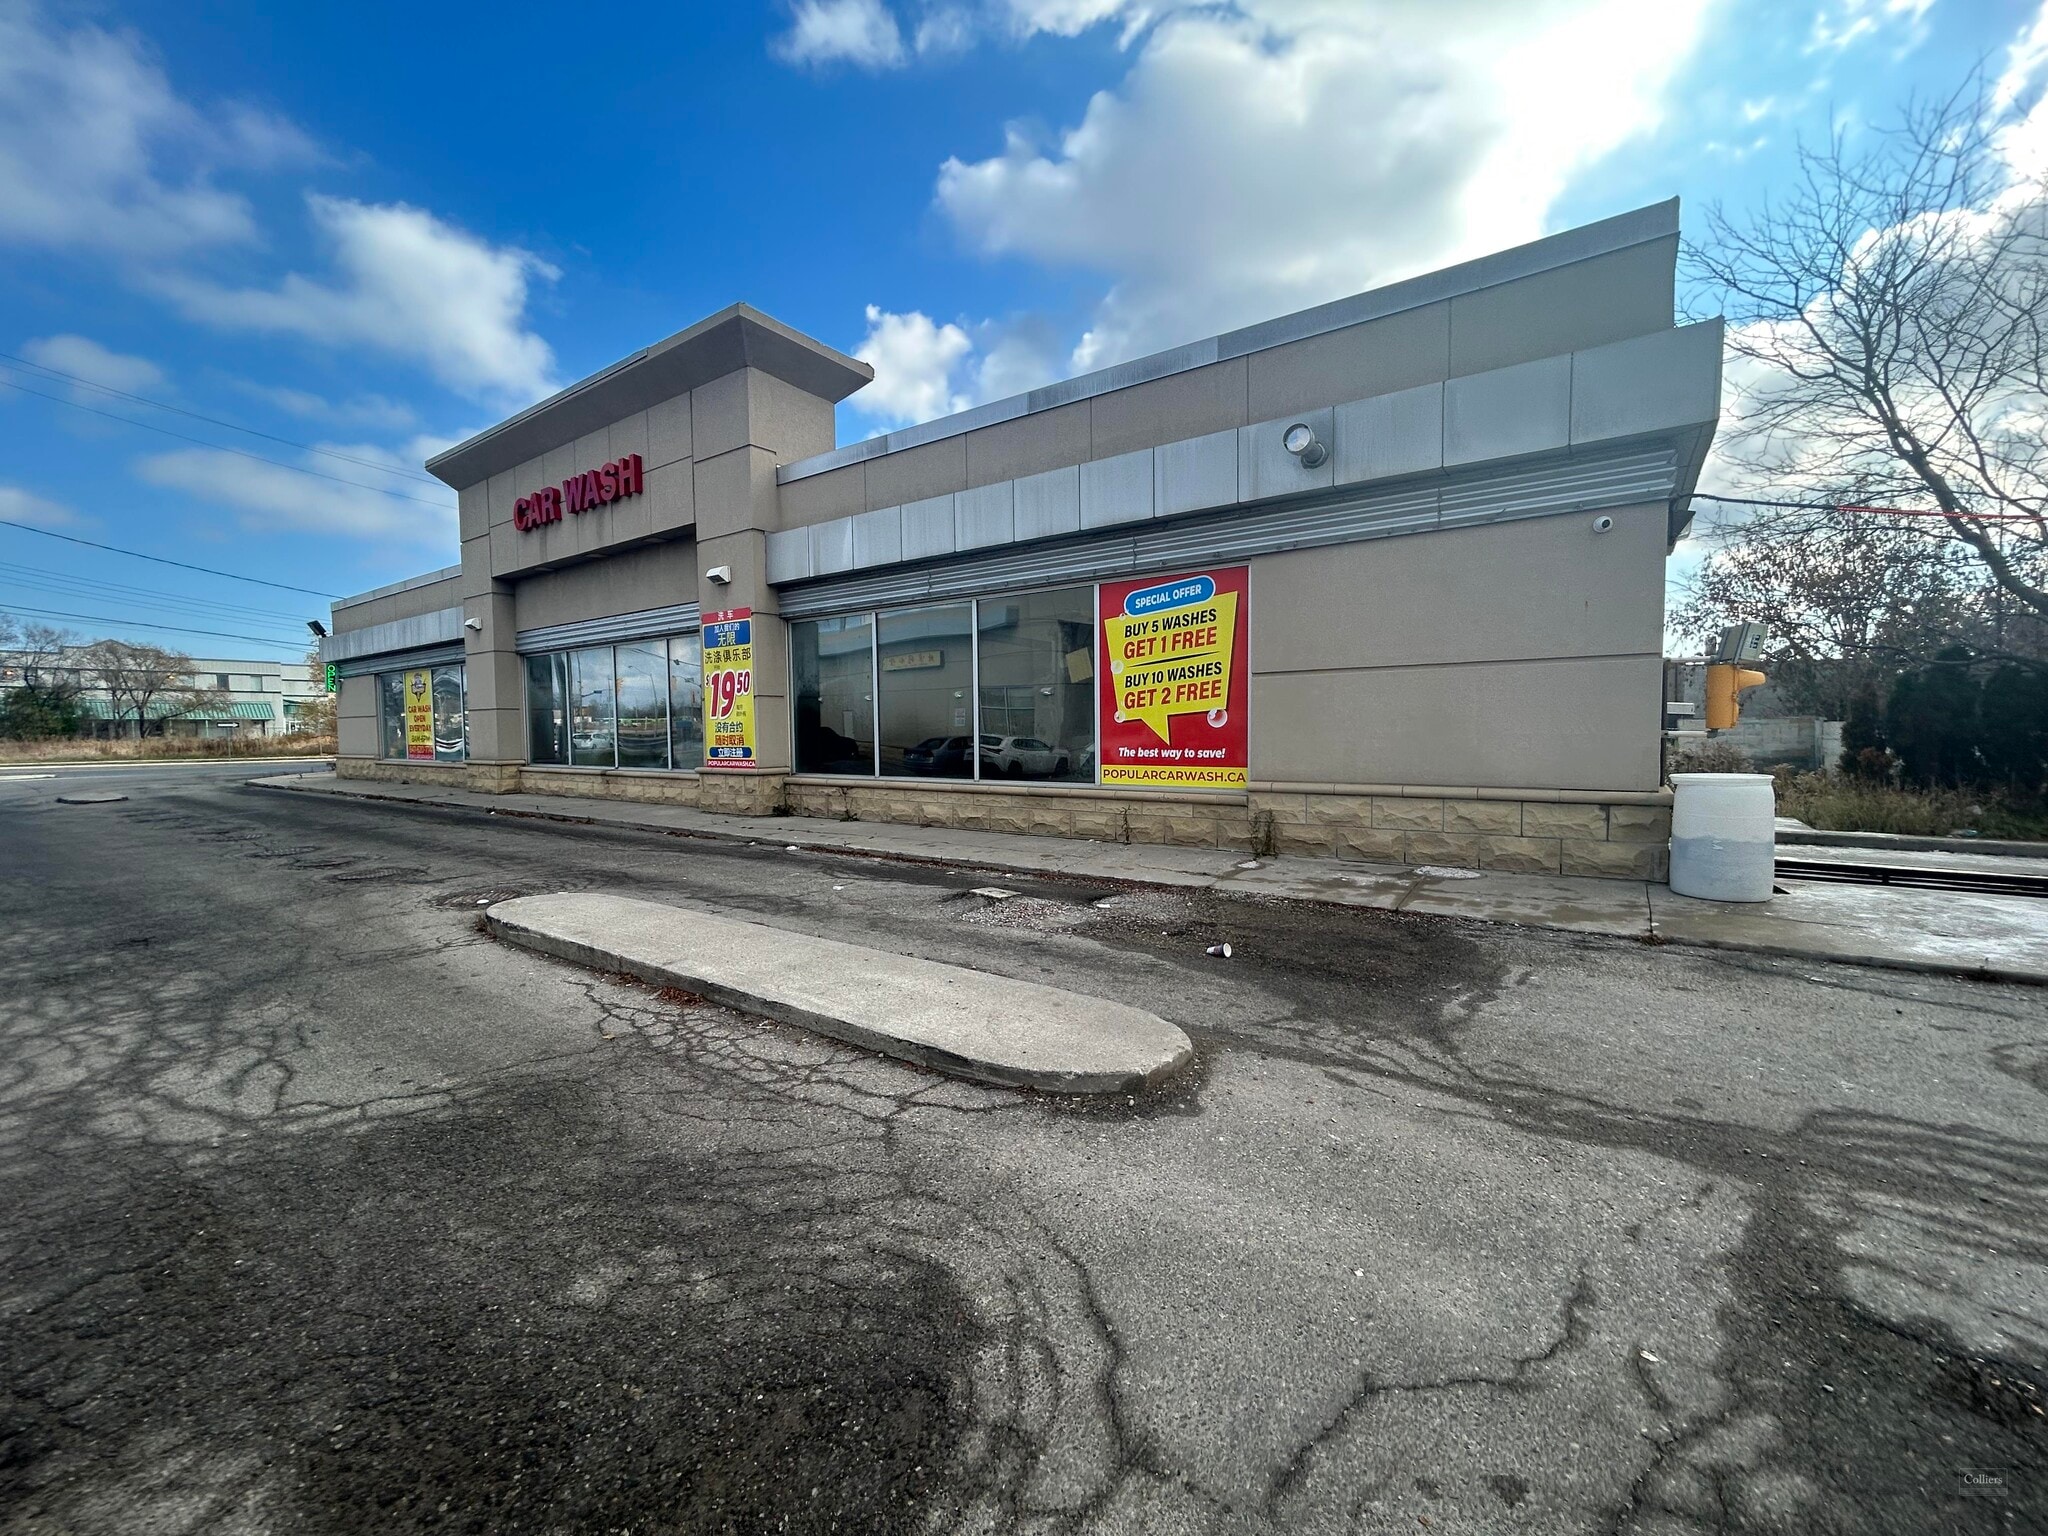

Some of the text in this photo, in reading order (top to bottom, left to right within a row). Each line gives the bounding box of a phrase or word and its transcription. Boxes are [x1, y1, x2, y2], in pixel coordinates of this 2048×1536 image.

[514, 453, 643, 532] CAR WASH
[1135, 584, 1202, 609] SPECIAL OFFER
[1125, 608, 1217, 638] BUY 5 WASHES
[717, 631, 736, 647] 无限
[1123, 626, 1218, 659] GET 1 FREE
[704, 647, 751, 665] 洗涤俱乐部
[328, 665, 336, 692] OPEN
[1125, 661, 1223, 688] BUY 10 WASHES
[1124, 679, 1222, 710] GET 2 FREE
[714, 721, 744, 733] 没有合约
[1118, 747, 1226, 760] The best way to save!
[1103, 769, 1246, 783] POPULARCARWASH.CA
